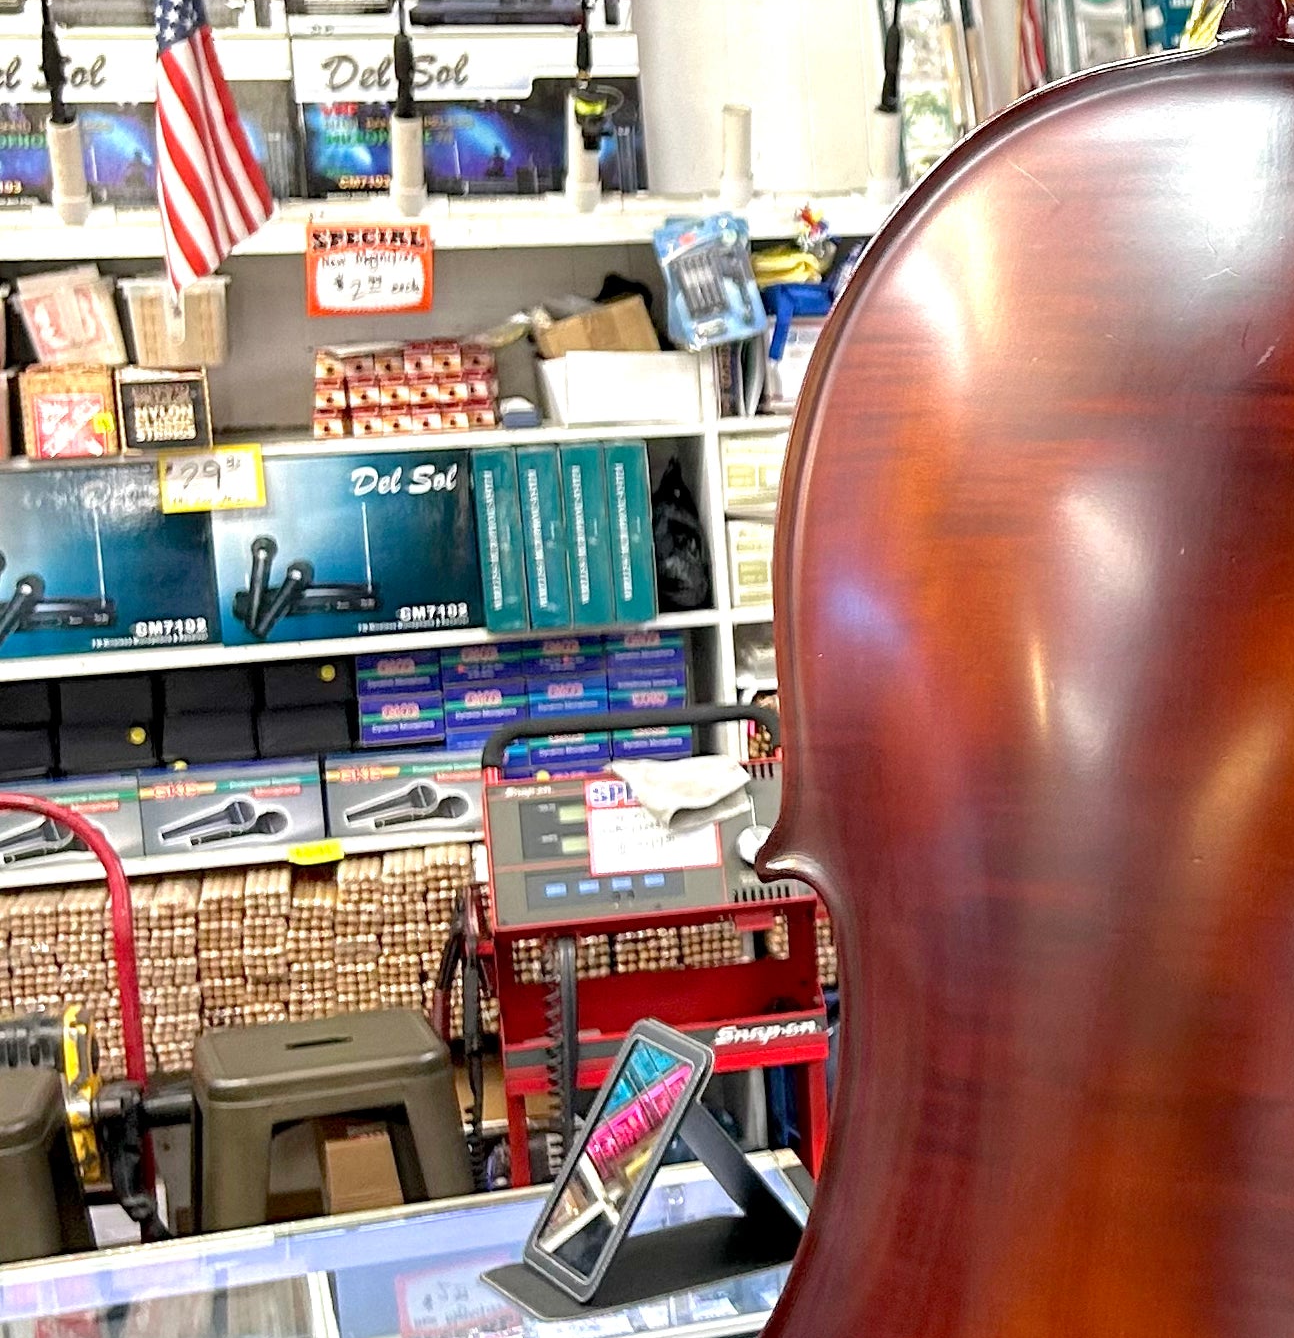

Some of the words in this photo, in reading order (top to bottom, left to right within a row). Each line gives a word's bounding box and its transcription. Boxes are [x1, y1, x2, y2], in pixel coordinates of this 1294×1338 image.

[321, 54, 392, 93] Del
[411, 53, 469, 90] Sol
[312, 227, 426, 253] SPECIAL
[350, 465, 402, 497] Del
[407, 462, 458, 495] Sol
[714, 1020, 818, 1046] Snap-on
